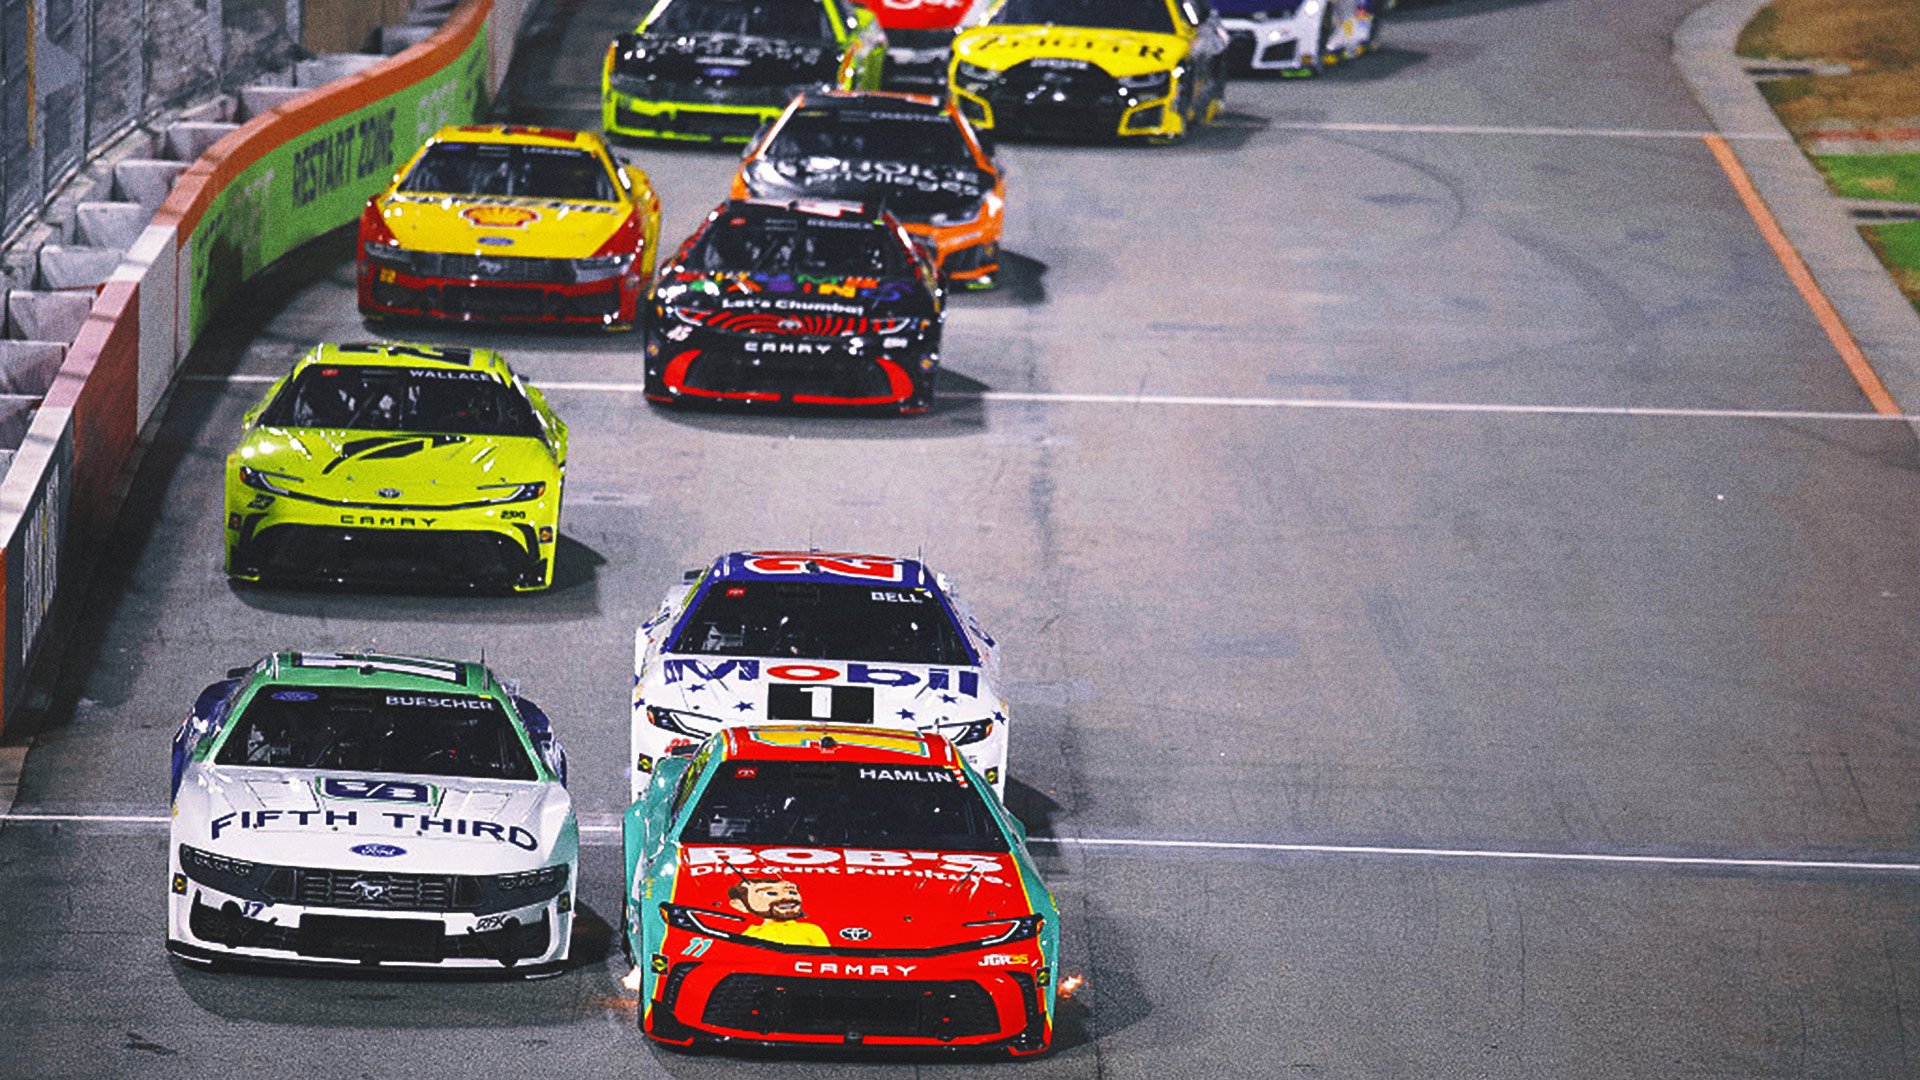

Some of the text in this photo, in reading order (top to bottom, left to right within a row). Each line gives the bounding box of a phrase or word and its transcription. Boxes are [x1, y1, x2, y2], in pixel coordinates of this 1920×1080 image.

[293, 124, 355, 208] RESTART
[357, 106, 396, 179] ZONE
[744, 341, 832, 354] CAMRY
[409, 369, 491, 382] WALLACE
[340, 514, 437, 527] CAMRY
[870, 591, 923, 604] BELL
[663, 658, 979, 699] Mobil
[385, 695, 495, 711] BUESCHER
[799, 685, 832, 719] 1
[859, 767, 952, 783] HAMLIN
[211, 811, 538, 851] FIFTH THIRD
[687, 846, 1003, 874] BOB'S
[690, 865, 841, 877] Discount
[242, 900, 264, 917] 17
[681, 937, 713, 957] 11
[794, 960, 918, 977] CAMRY
